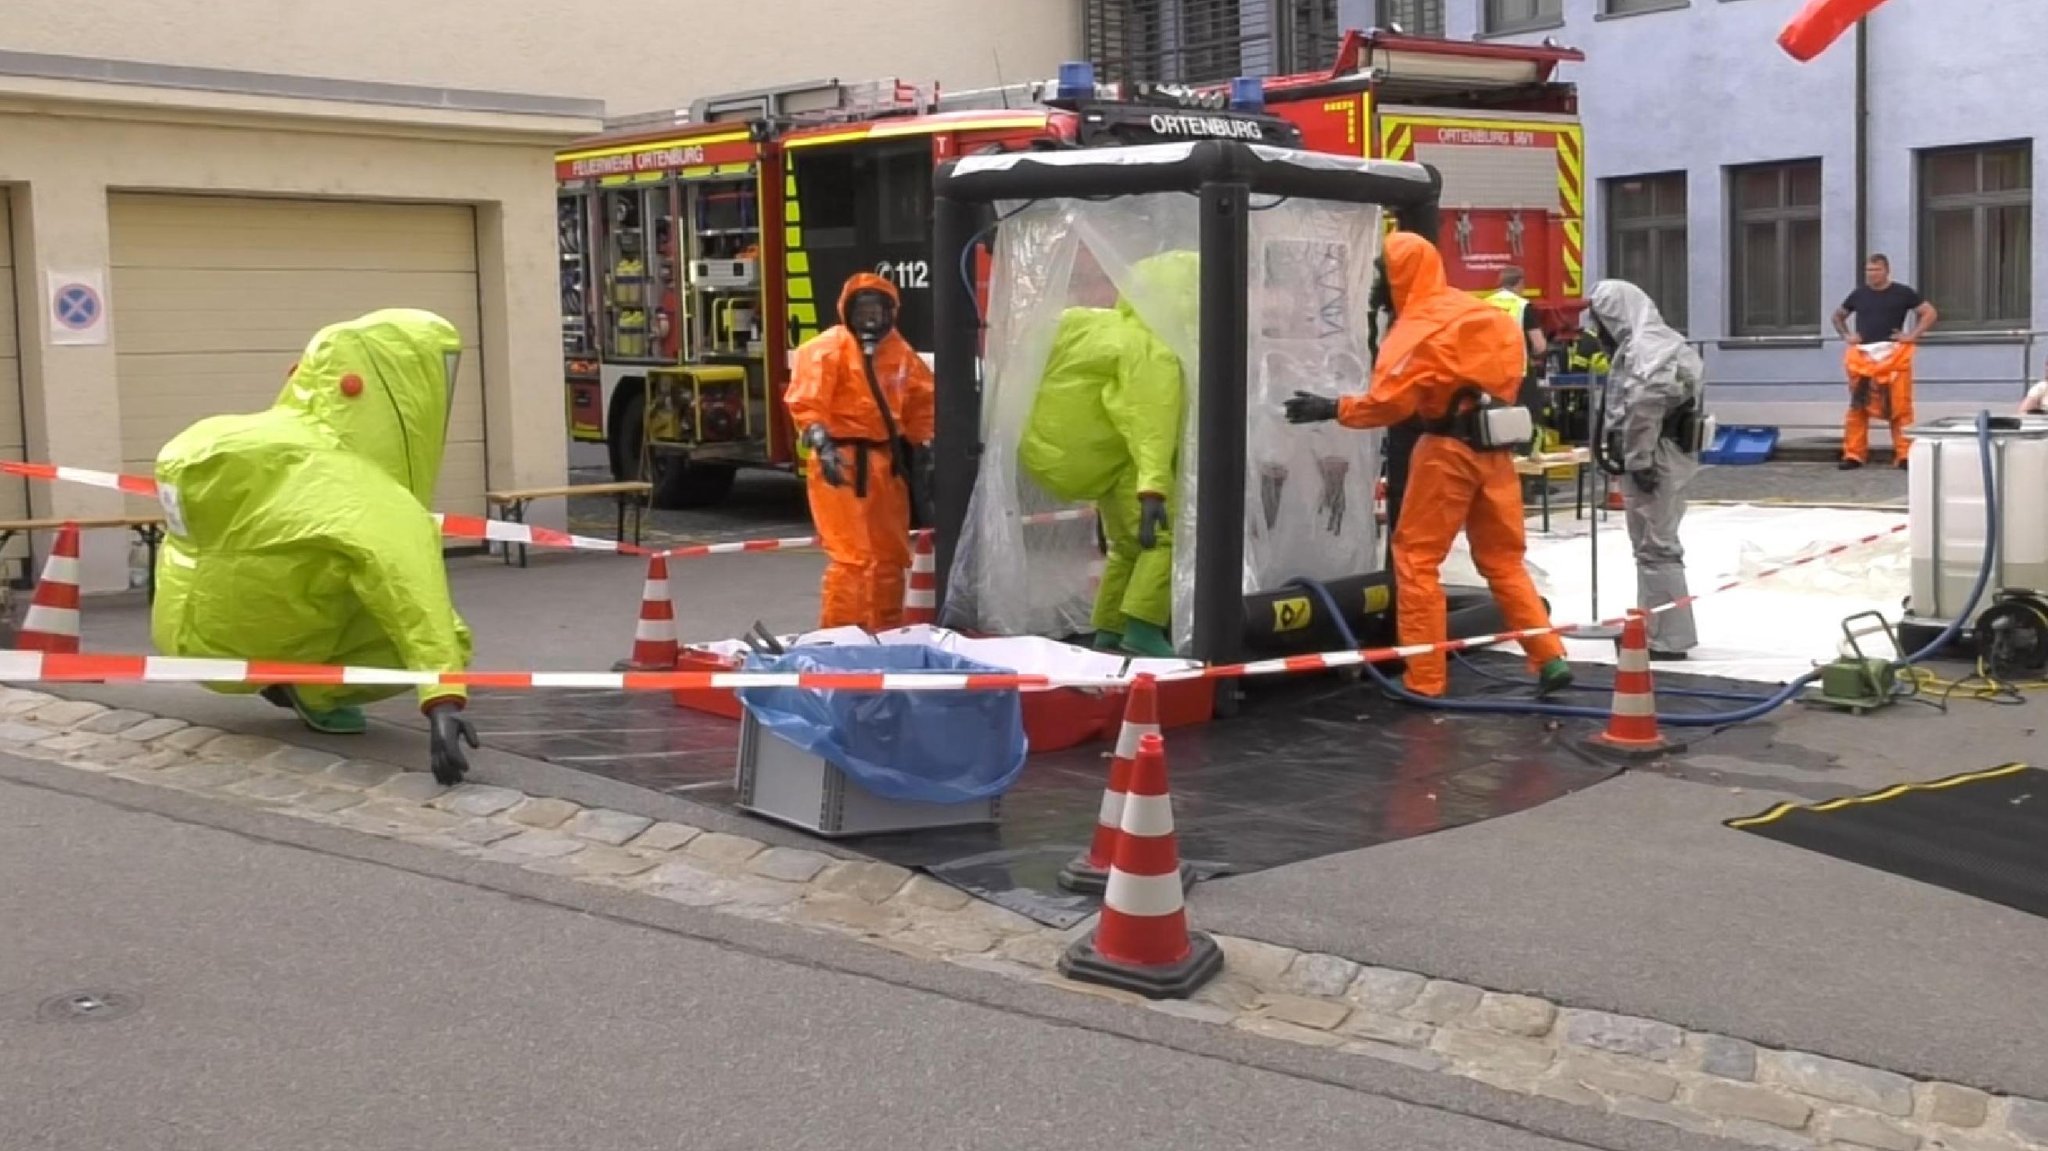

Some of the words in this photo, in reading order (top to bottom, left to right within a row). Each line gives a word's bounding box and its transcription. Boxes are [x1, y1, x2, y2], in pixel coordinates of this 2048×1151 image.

[1150, 114, 1262, 139] ORTENBURG
[1438, 127, 1509, 145] ORTENBURG
[572, 154, 633, 175] FEUERWEHR
[635, 145, 703, 169] ORTENBURG
[895, 260, 930, 288] 112
